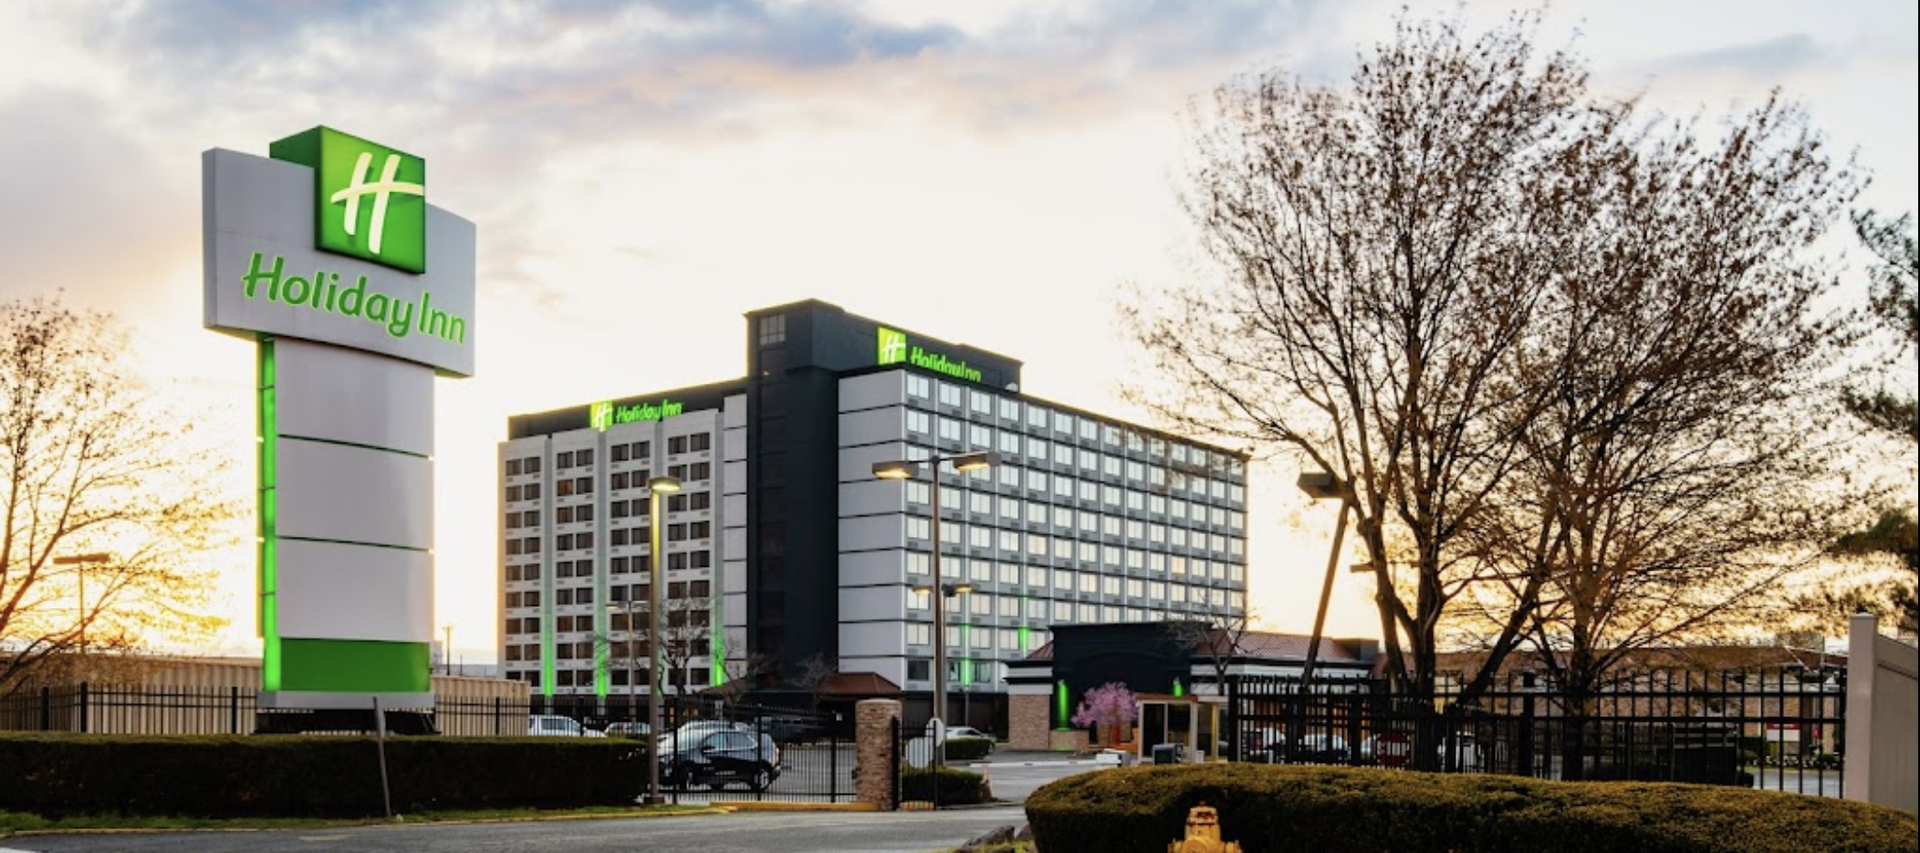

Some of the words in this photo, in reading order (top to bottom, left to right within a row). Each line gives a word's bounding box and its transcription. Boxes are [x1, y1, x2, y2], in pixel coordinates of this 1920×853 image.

[242, 252, 413, 337] Holiday
[418, 291, 465, 343] Inn
[616, 402, 661, 423] Holiday
[662, 399, 682, 417] Inn
